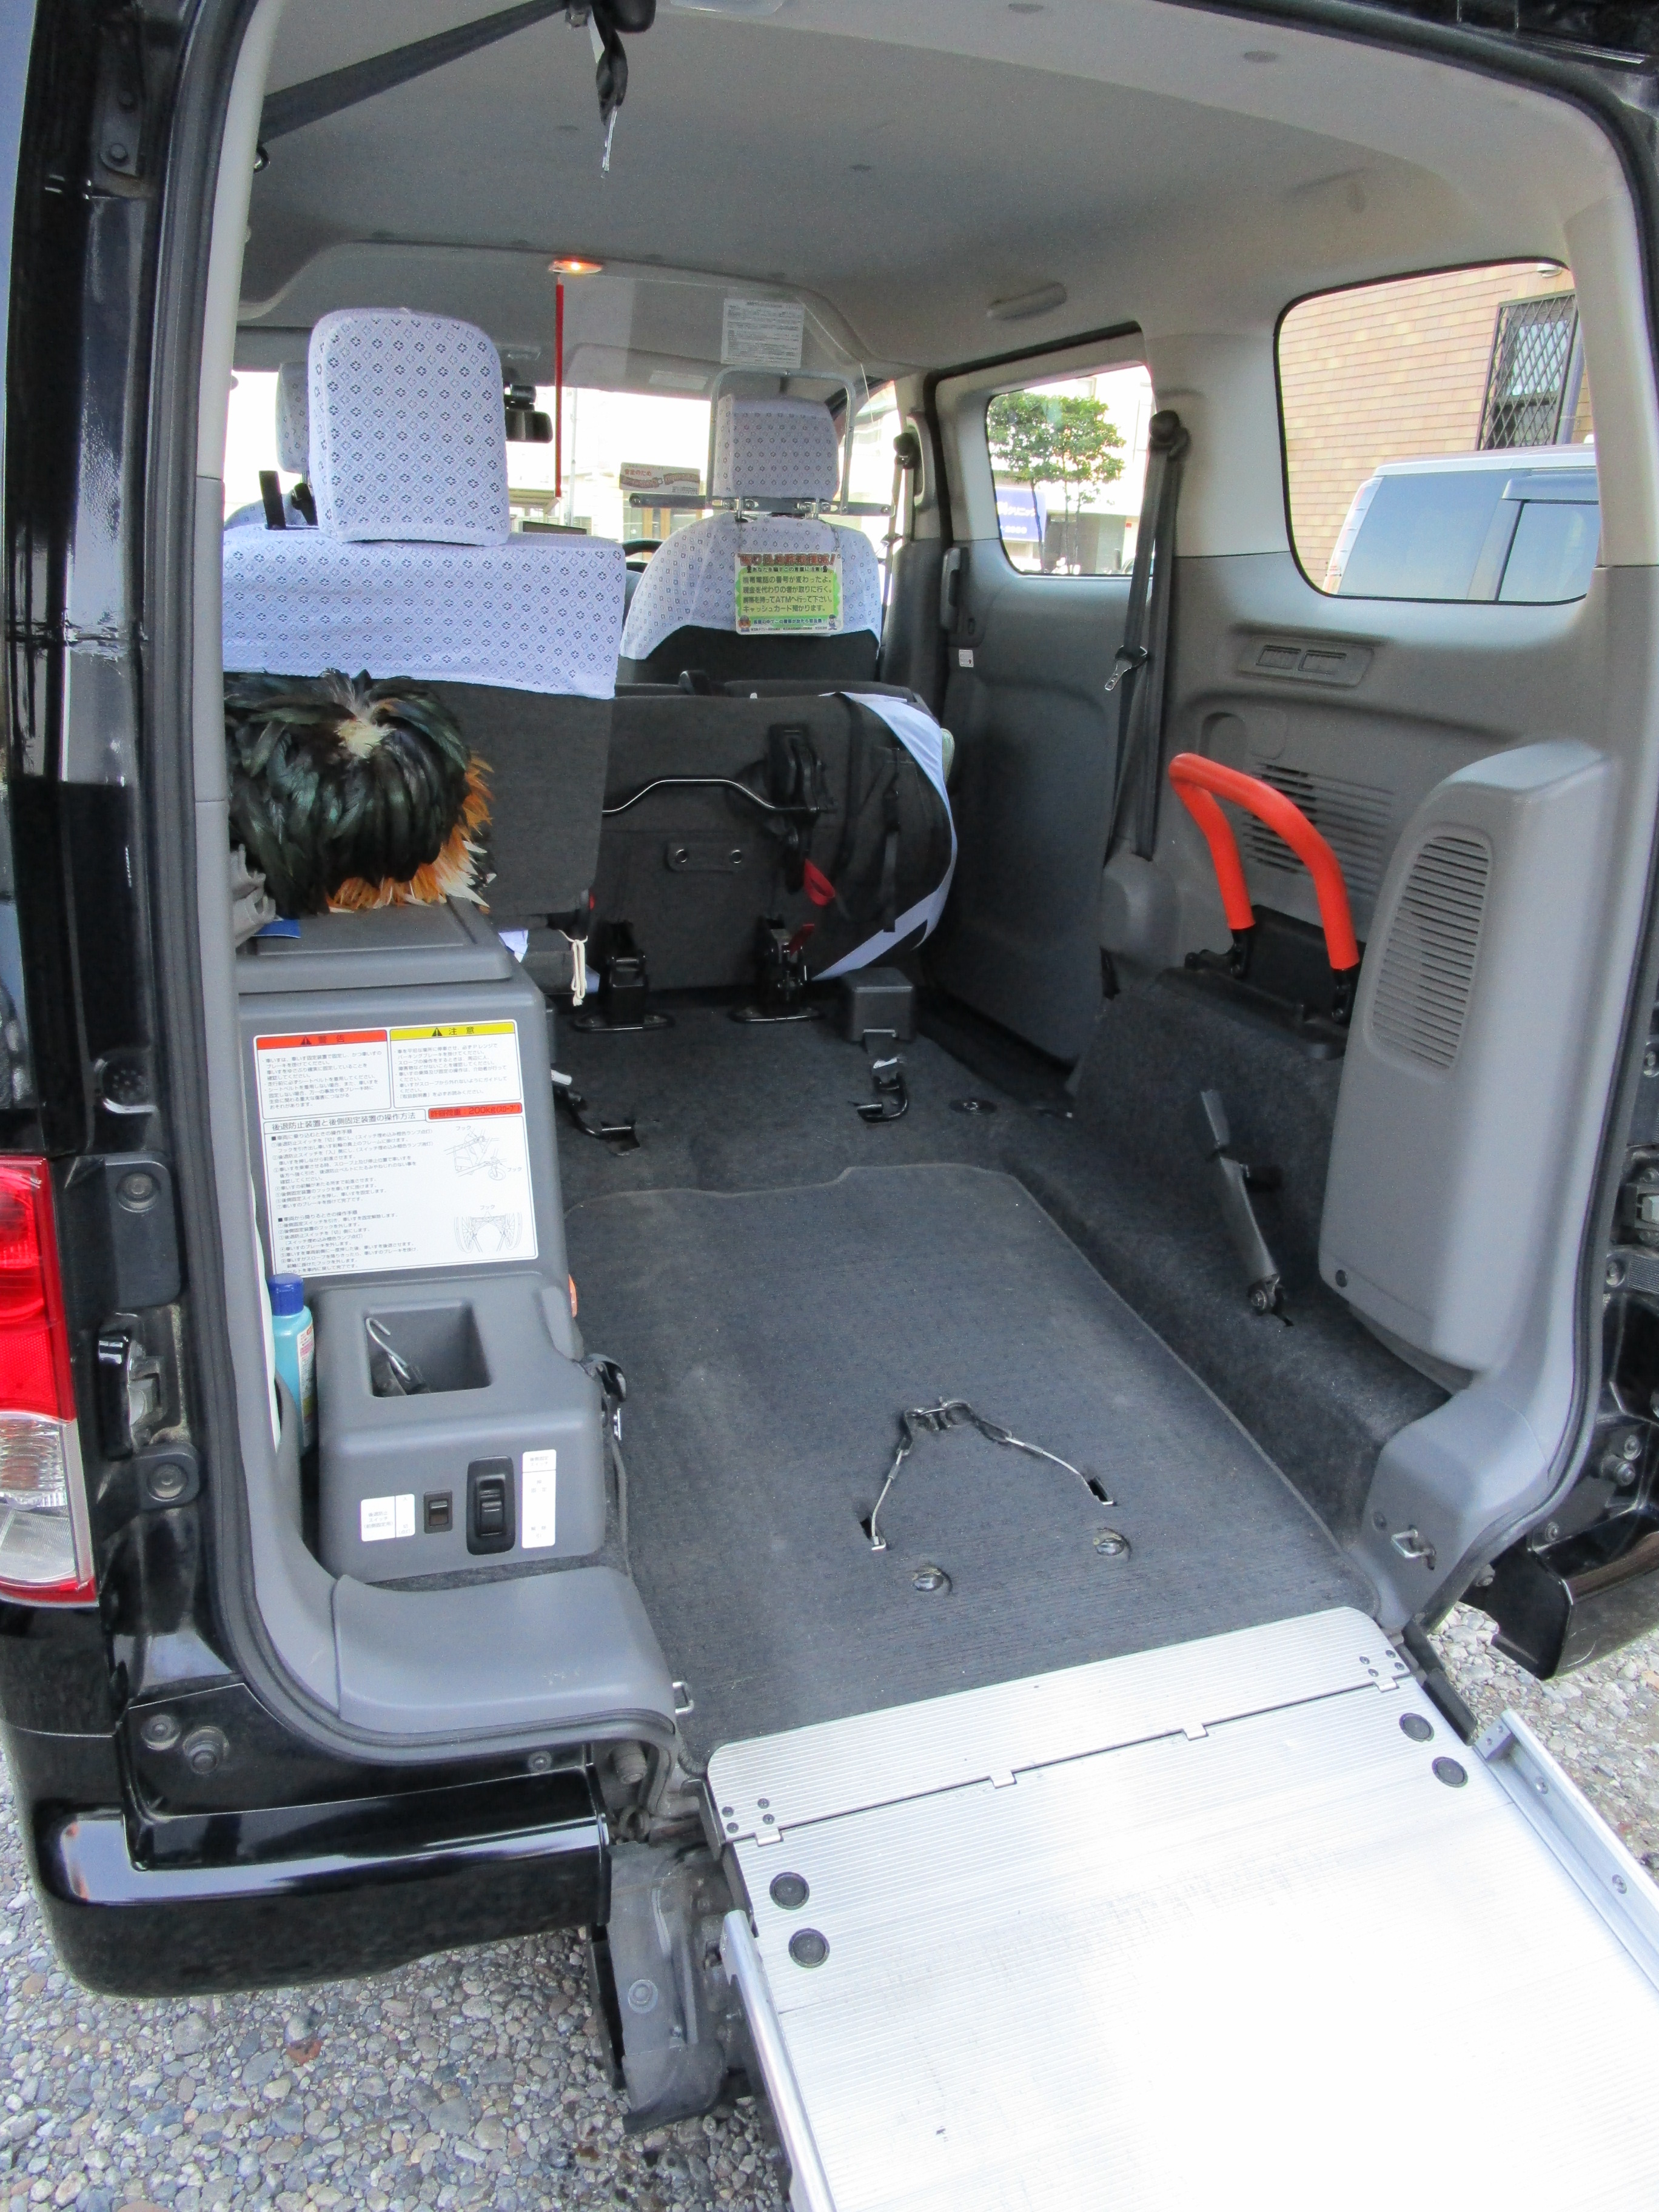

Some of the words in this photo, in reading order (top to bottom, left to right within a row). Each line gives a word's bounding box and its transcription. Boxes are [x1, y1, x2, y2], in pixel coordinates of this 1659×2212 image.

[267, 1060, 330, 1069] ブレーキを掛けてください。
[398, 1061, 494, 1071] 障害物などがないことを確認してください。
[272, 1112, 416, 1131] 後退防止装置と後側固定装置の操作方法
[279, 1155, 355, 1165] 車いすを押しながら前進させます。
